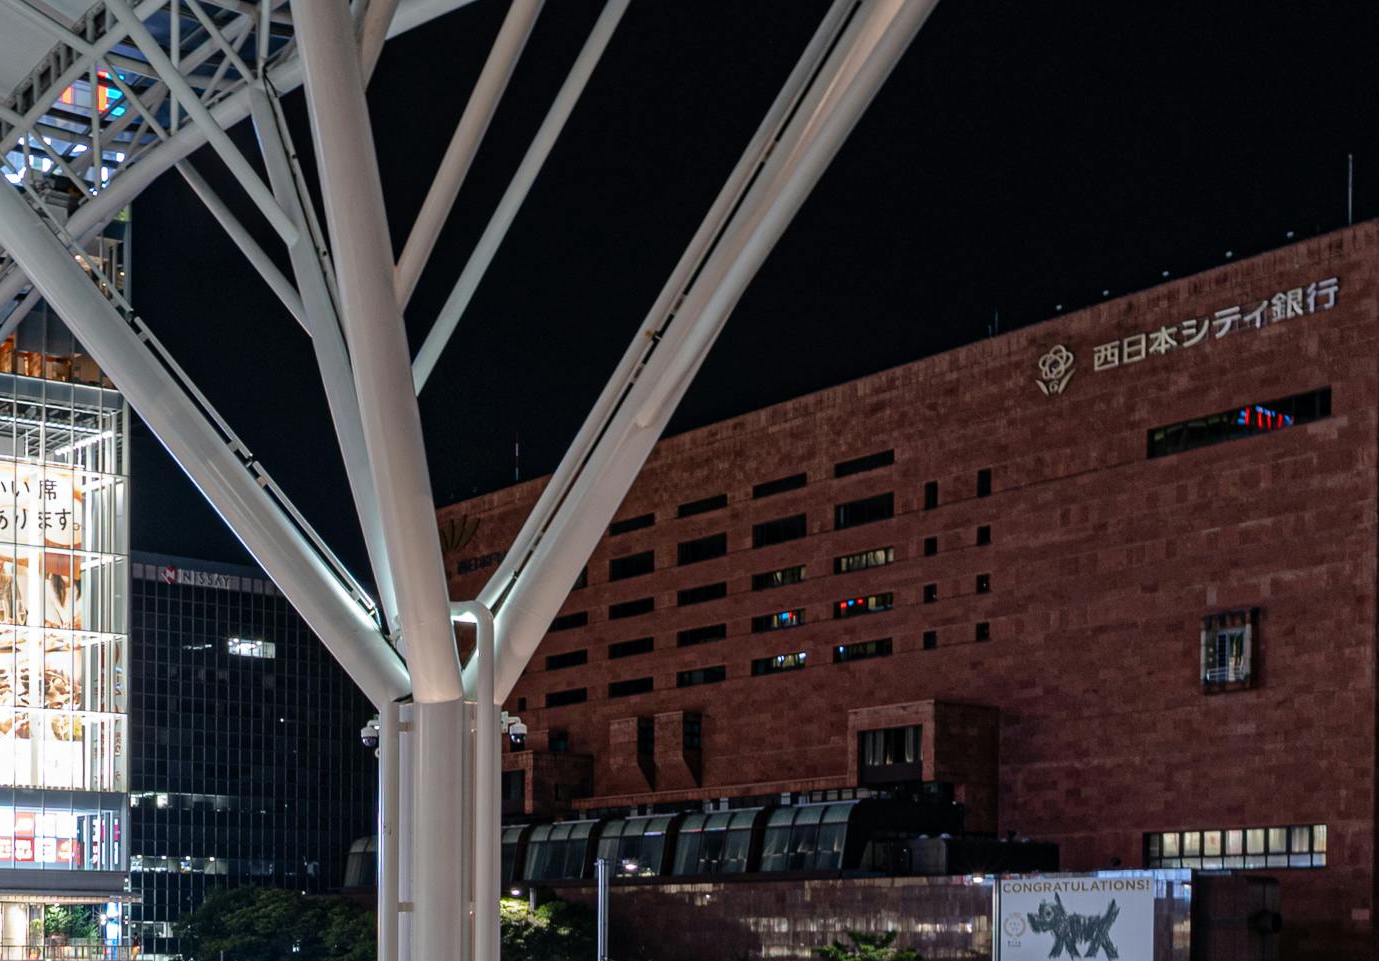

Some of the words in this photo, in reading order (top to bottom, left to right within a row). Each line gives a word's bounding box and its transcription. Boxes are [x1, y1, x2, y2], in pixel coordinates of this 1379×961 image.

[1093, 276, 1339, 372] 西日本シティ銀行
[183, 570, 229, 587] NISSAY
[1002, 879, 1150, 893] CONGRATULATIONS!
